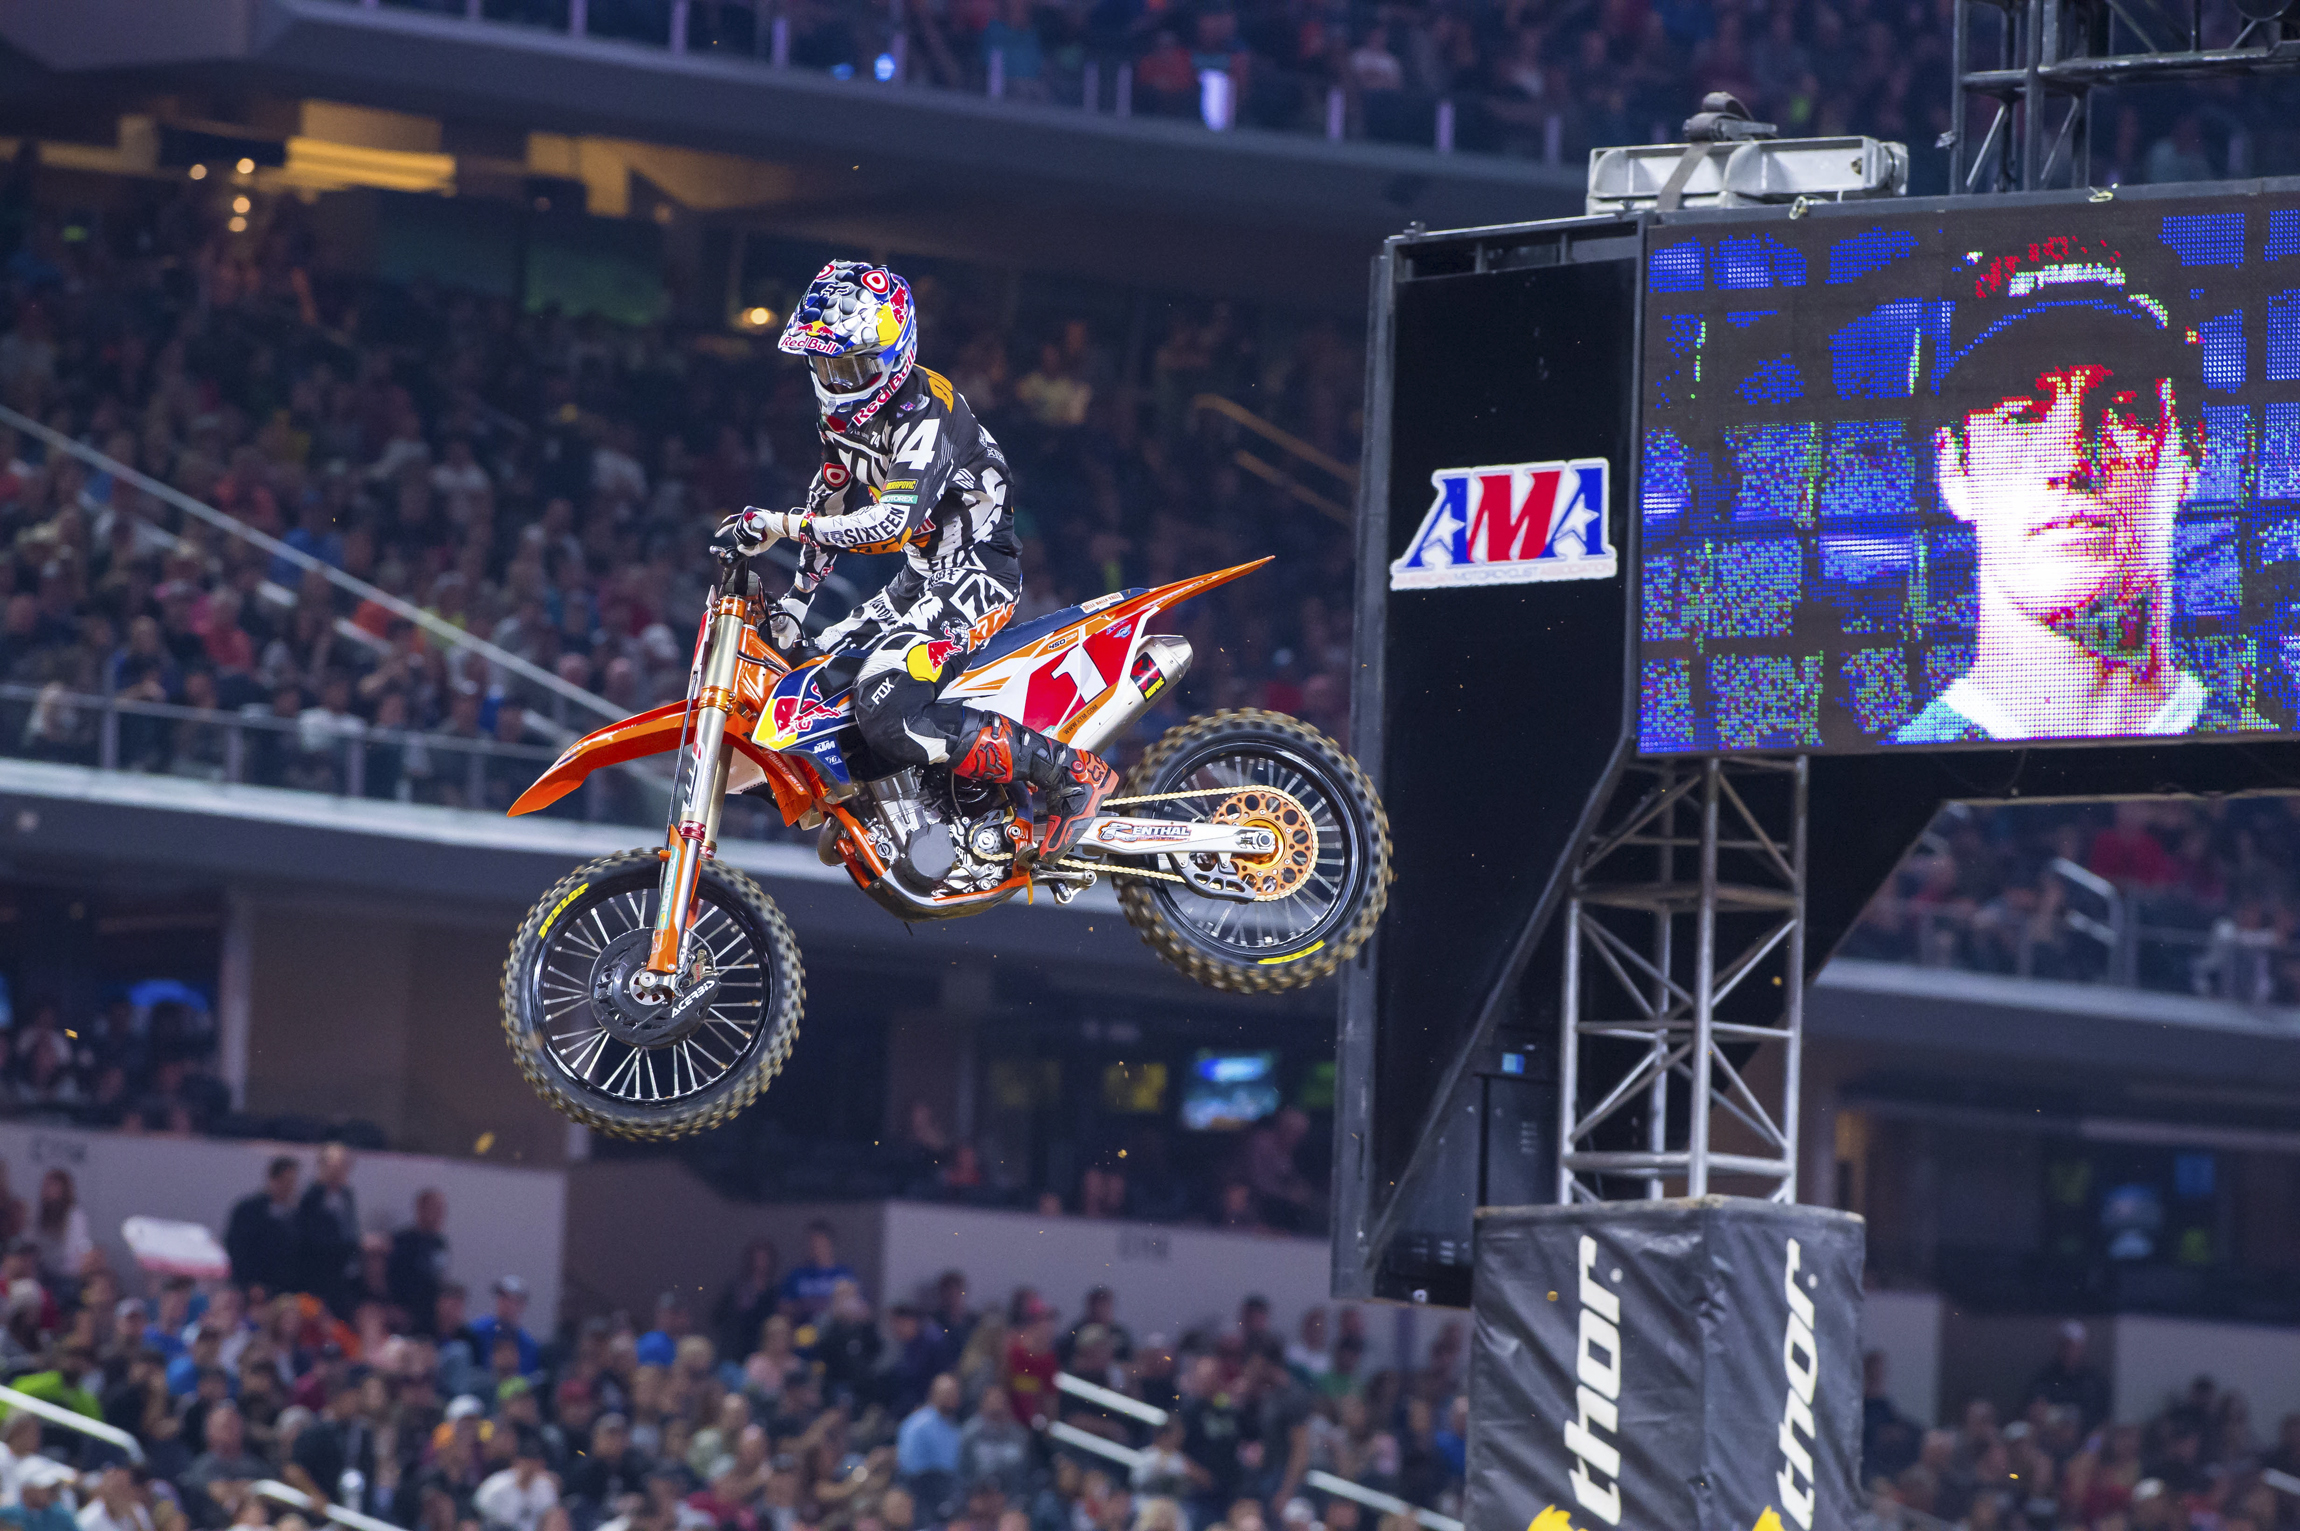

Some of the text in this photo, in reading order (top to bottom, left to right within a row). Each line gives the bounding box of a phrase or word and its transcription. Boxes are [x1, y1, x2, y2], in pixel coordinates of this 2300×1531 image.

[780, 336, 837, 354] Red Bull
[852, 386, 891, 426] Red
[888, 349, 917, 393] Bull
[1404, 465, 1608, 569] AMA
[1048, 638, 1067, 650] 450
[870, 676, 896, 706] FOX
[1050, 642, 1108, 705] 1
[1063, 703, 1099, 736] WWW.KTM.COM
[813, 740, 836, 754] KTM
[1100, 822, 1191, 842] RENTHAL
[671, 980, 716, 1019] ACERBIS
[1564, 1235, 1621, 1526] thor
[1776, 1238, 1818, 1531] thor
